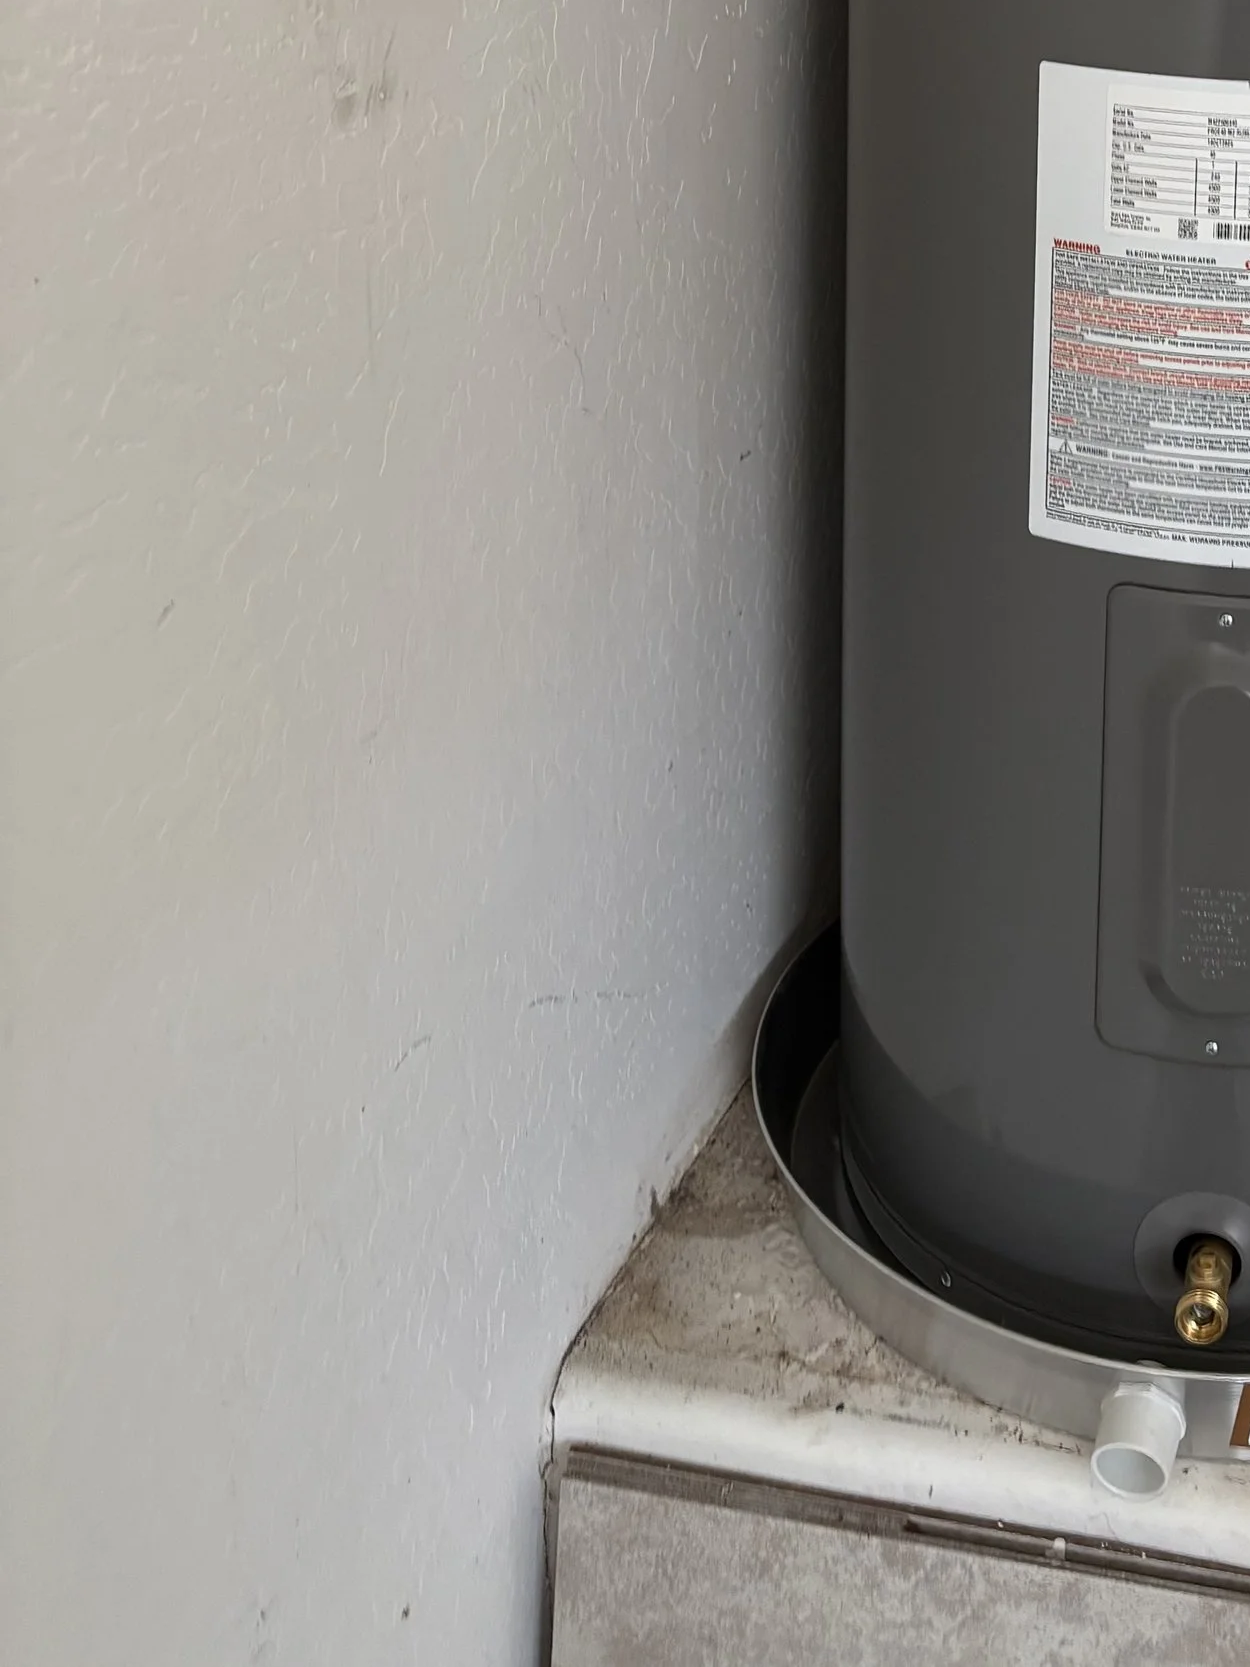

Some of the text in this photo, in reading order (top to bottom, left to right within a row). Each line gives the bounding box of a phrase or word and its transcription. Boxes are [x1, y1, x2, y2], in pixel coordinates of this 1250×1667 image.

[1053, 238, 1101, 254] WARNING
[1161, 252, 1186, 263] WATER
[1188, 255, 1217, 265] HEATER
